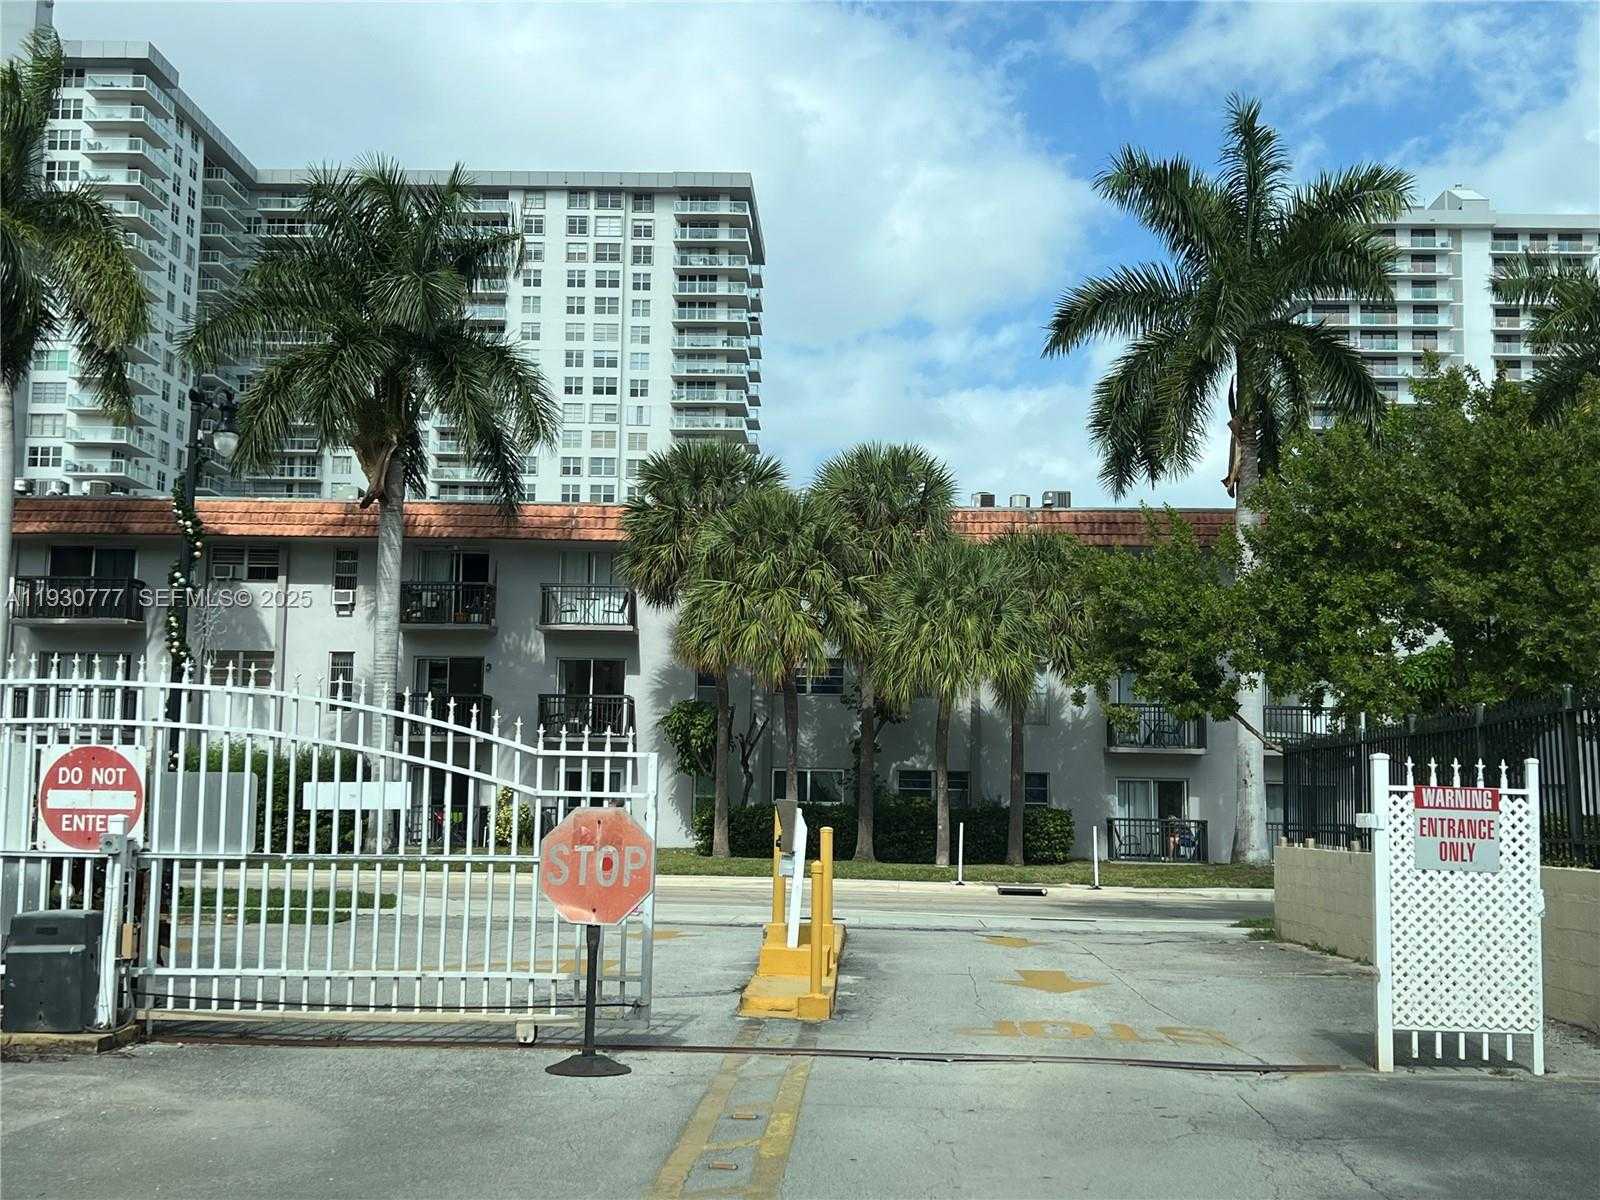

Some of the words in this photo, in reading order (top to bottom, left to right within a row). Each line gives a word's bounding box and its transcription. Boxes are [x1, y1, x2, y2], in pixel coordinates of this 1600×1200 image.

[58, 767, 83, 785] DO
[91, 767, 127, 785] NOT
[1422, 788, 1493, 809] WARNING
[61, 814, 118, 832] ENTE
[1419, 817, 1495, 840] ENTRANCE
[1439, 841, 1476, 862] ONLY
[546, 844, 647, 887] STOP
